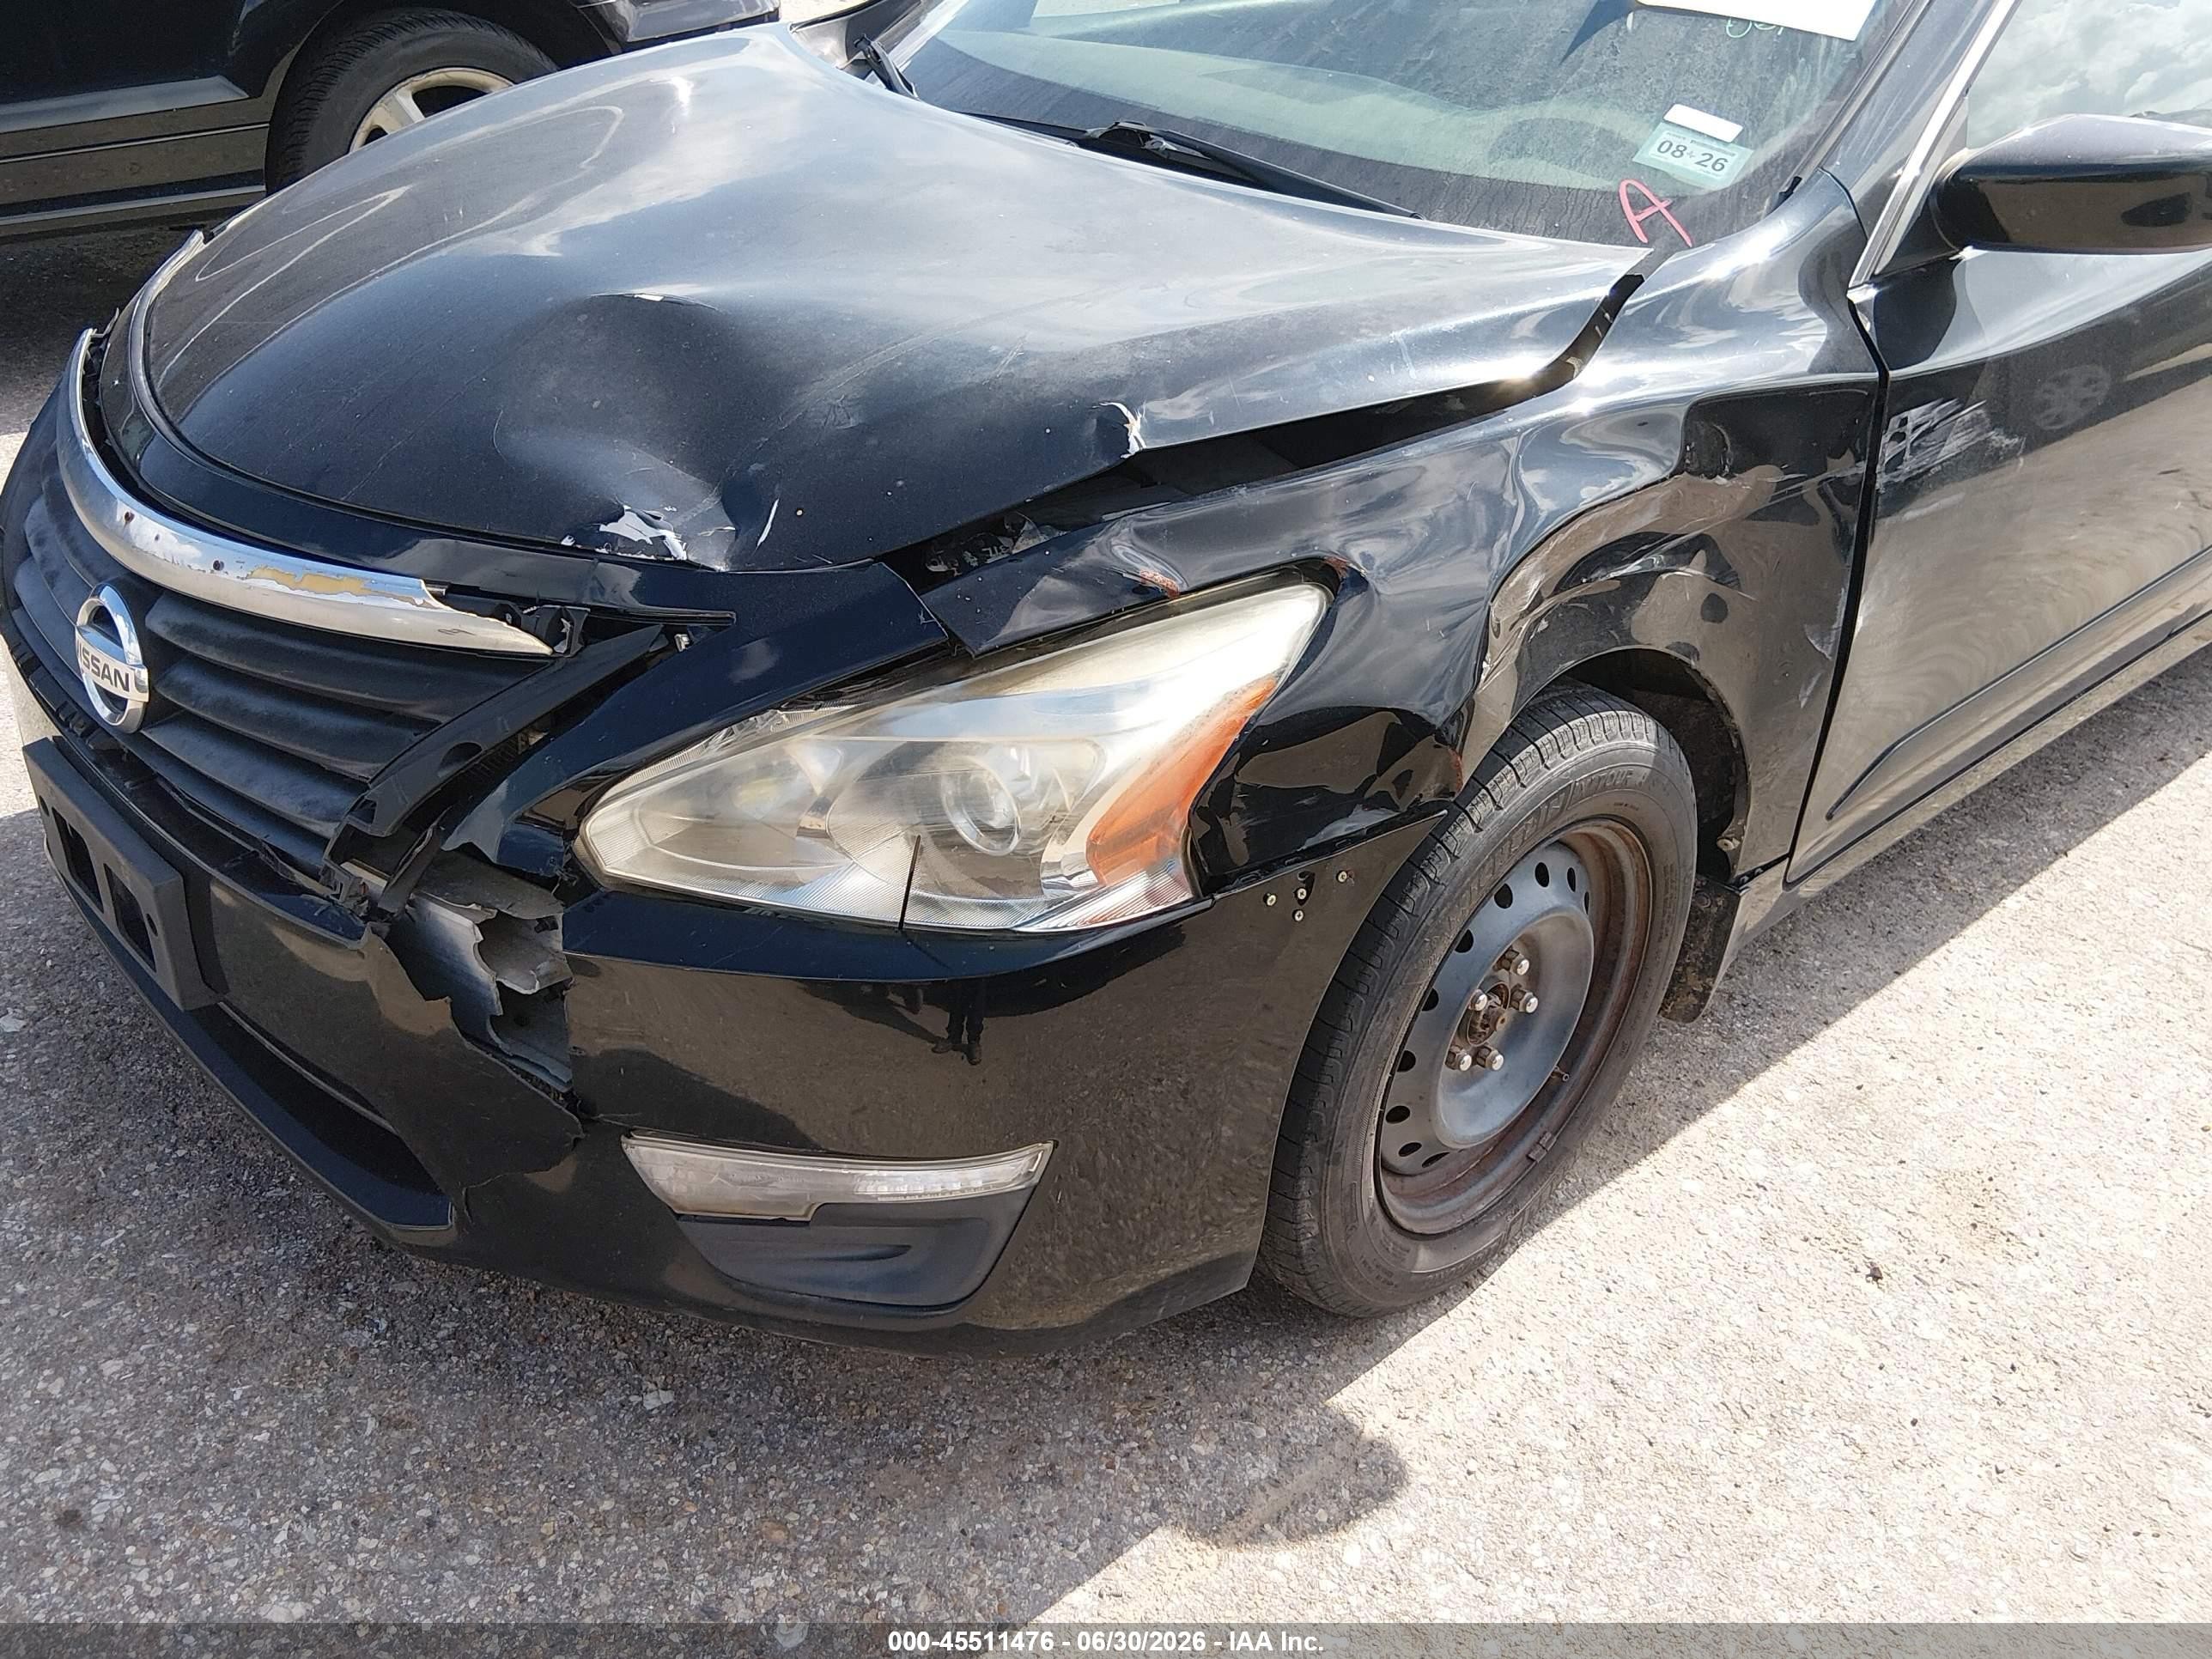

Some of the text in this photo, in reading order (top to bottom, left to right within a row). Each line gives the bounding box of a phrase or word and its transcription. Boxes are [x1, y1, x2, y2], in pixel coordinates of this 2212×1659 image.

[1657, 140, 1687, 159] 08
[1694, 153, 1729, 172] 26
[1618, 179, 1692, 248] A
